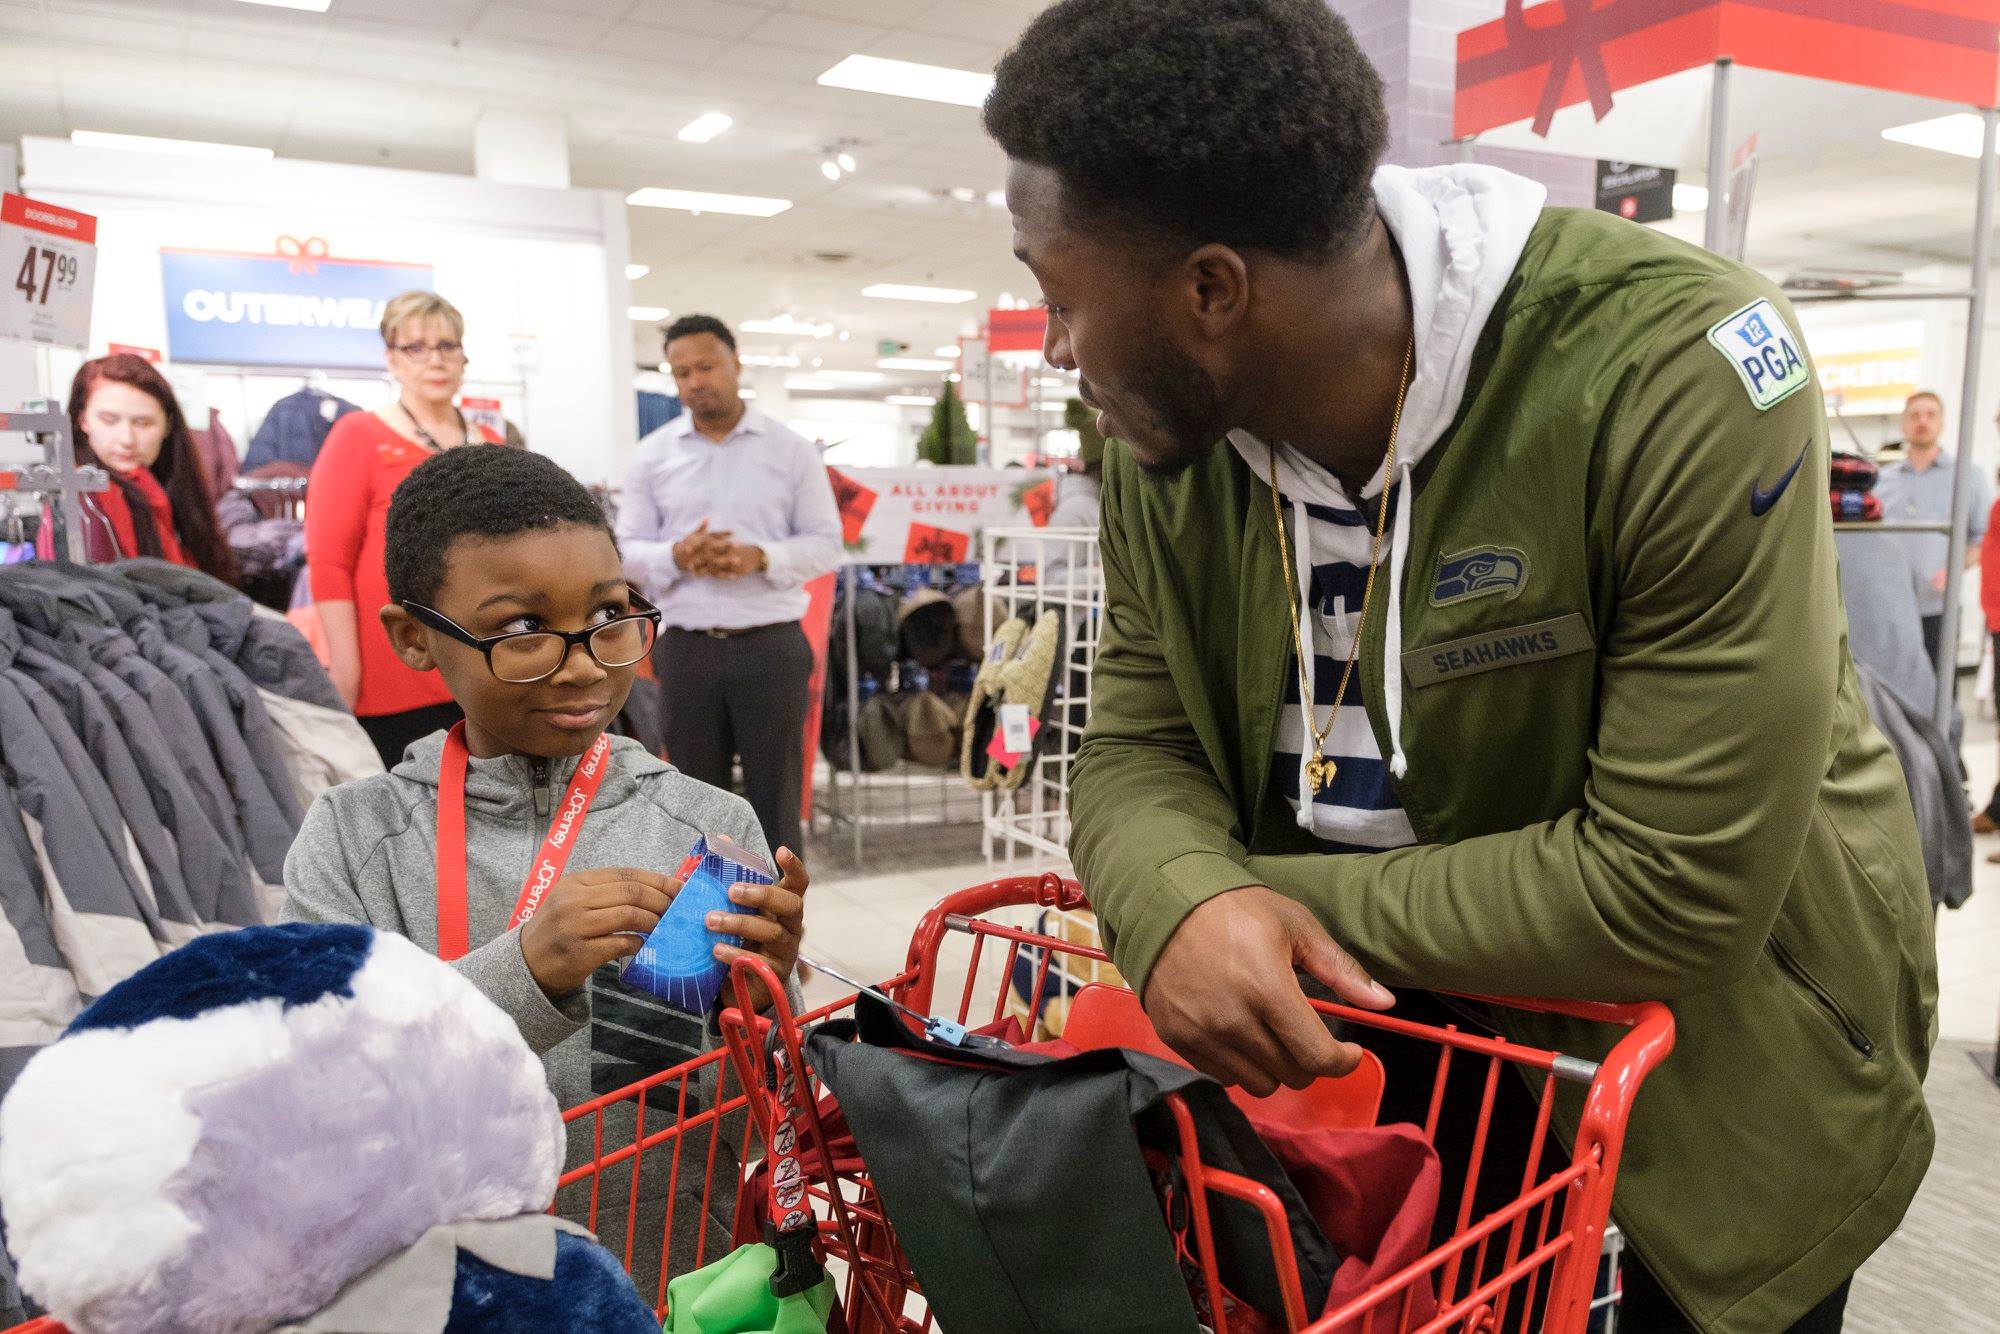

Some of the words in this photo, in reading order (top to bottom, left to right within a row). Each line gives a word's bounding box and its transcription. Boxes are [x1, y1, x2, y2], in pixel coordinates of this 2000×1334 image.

[1742, 337, 1802, 394] PGA
[891, 483, 925, 497] ALL
[935, 483, 999, 498] ABOUT
[911, 501, 979, 512] GIVING
[1432, 630, 1559, 674] SEAHAWKS
[549, 787, 587, 849] JCPenney
[516, 859, 557, 924] JCPenney
